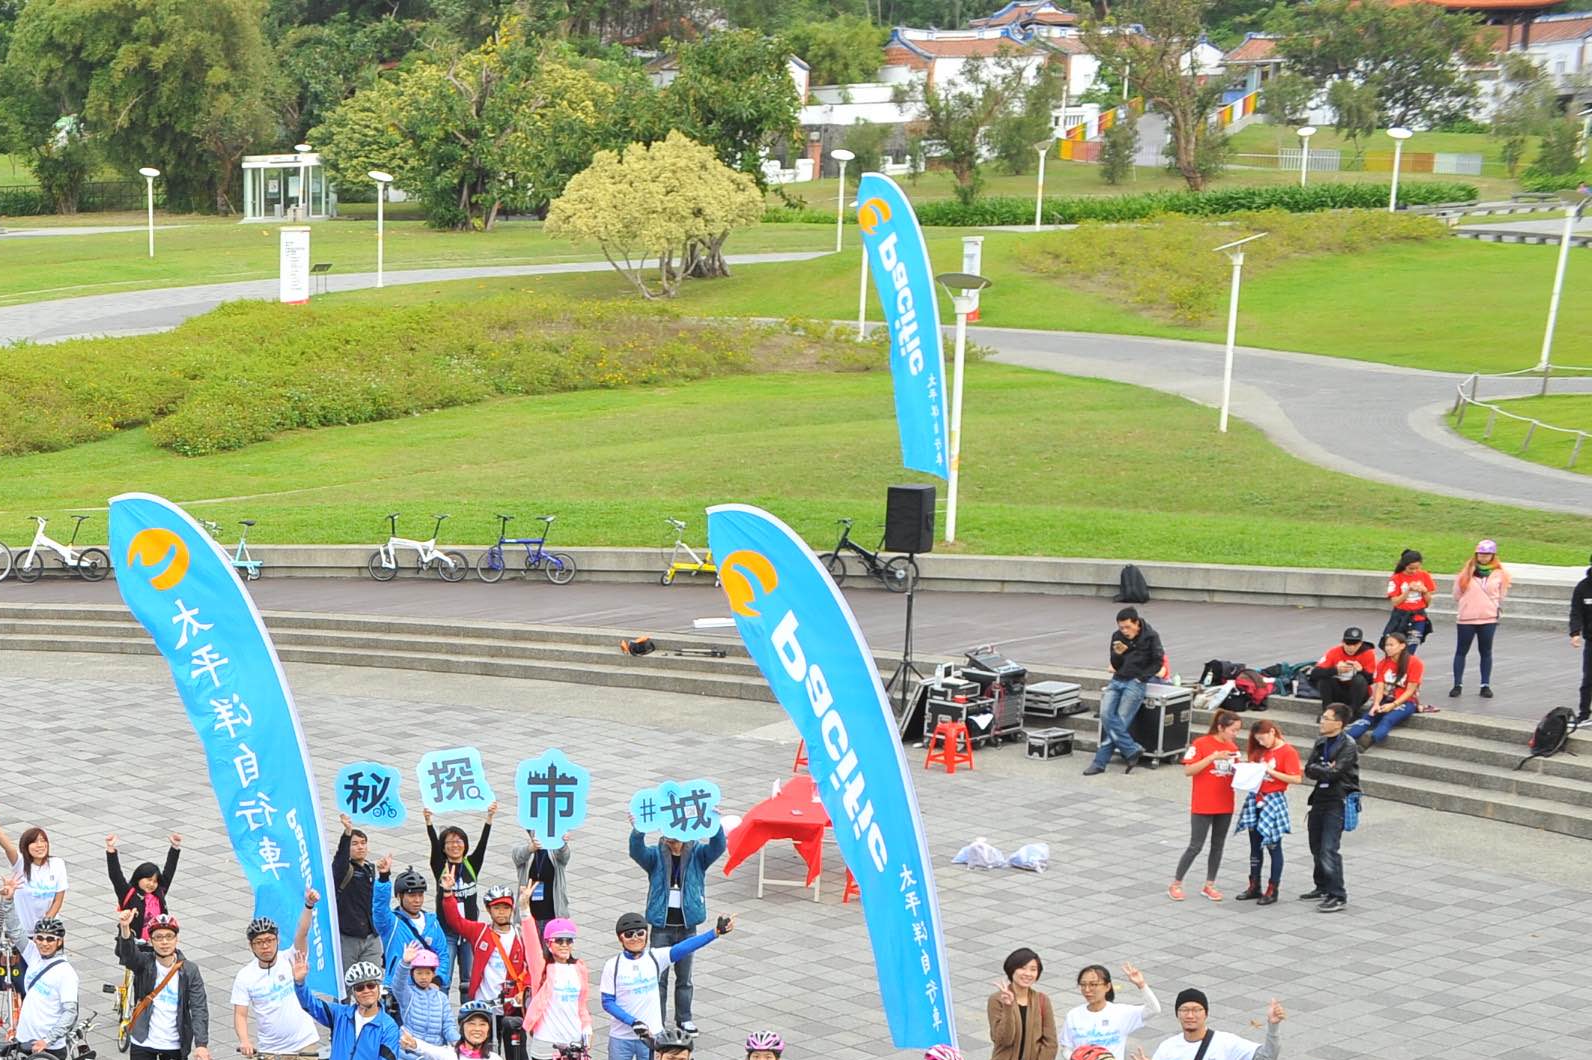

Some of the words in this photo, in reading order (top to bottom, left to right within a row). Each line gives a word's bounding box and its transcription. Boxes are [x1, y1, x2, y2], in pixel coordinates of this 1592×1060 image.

[343, 771, 391, 814] 秘
[428, 757, 477, 803] 探
[527, 761, 579, 838] 市
